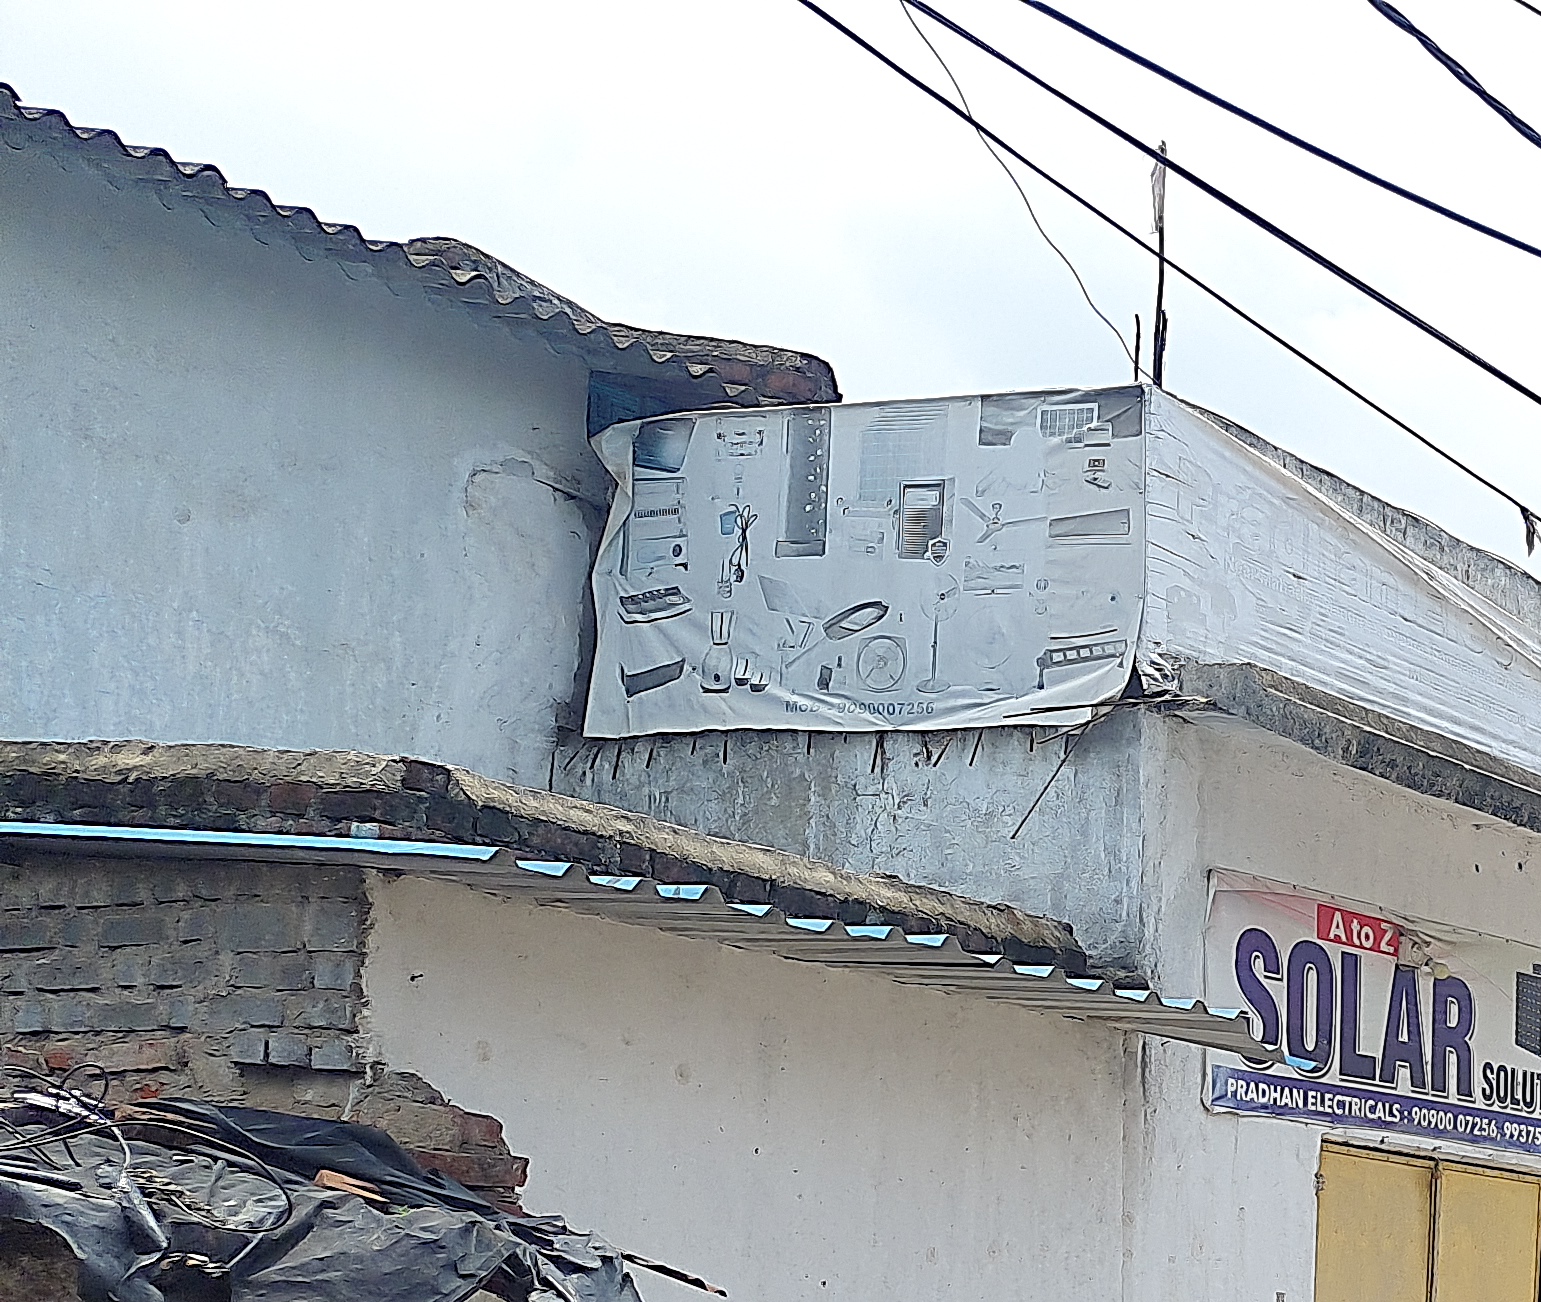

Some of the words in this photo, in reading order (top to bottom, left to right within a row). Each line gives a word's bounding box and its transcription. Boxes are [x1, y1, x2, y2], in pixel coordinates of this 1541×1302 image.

[837, 701, 935, 715] 9090007256
[1328, 911, 1349, 941] A
[1351, 917, 1374, 951] to
[1379, 923, 1397, 954] Z
[1235, 926, 1476, 1099] SOLAR
[1227, 1078, 1304, 1109] PRADHAN
[1307, 1090, 1401, 1123] ELECTRICALS
[1411, 1106, 1453, 1129] 90900
